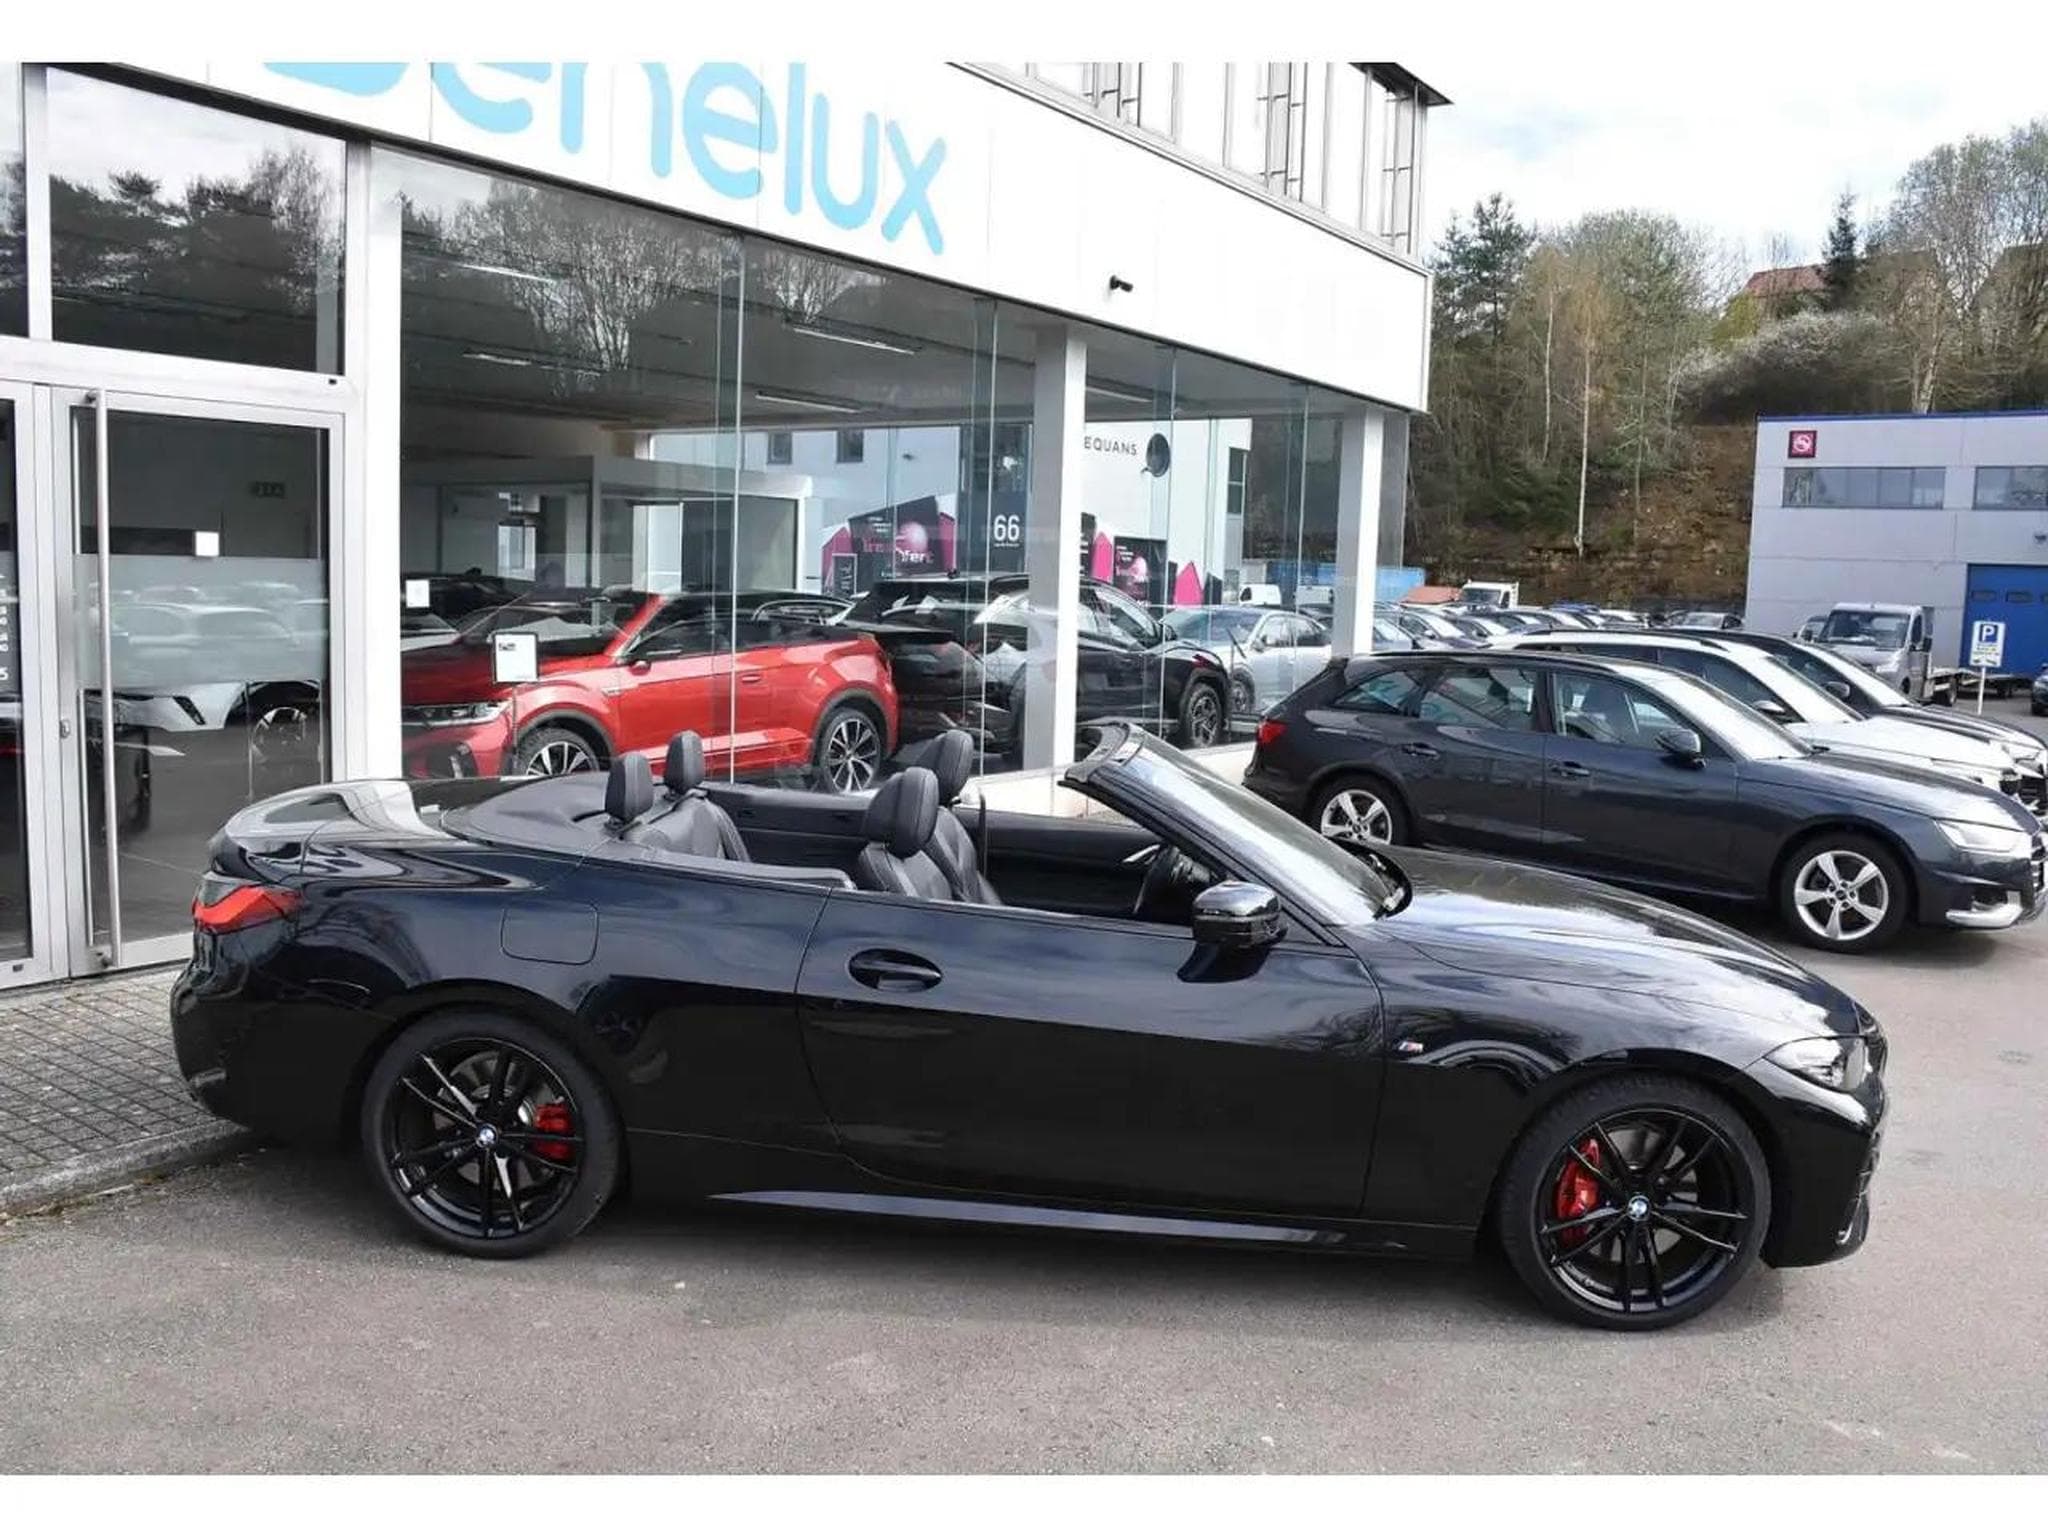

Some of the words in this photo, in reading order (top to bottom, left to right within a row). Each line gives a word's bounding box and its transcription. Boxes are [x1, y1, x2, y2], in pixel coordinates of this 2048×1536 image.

[263, 62, 947, 255] enelux
[1083, 436, 1137, 456] EQUANS
[993, 514, 1020, 541] 66
[1982, 625, 1995, 641] P
